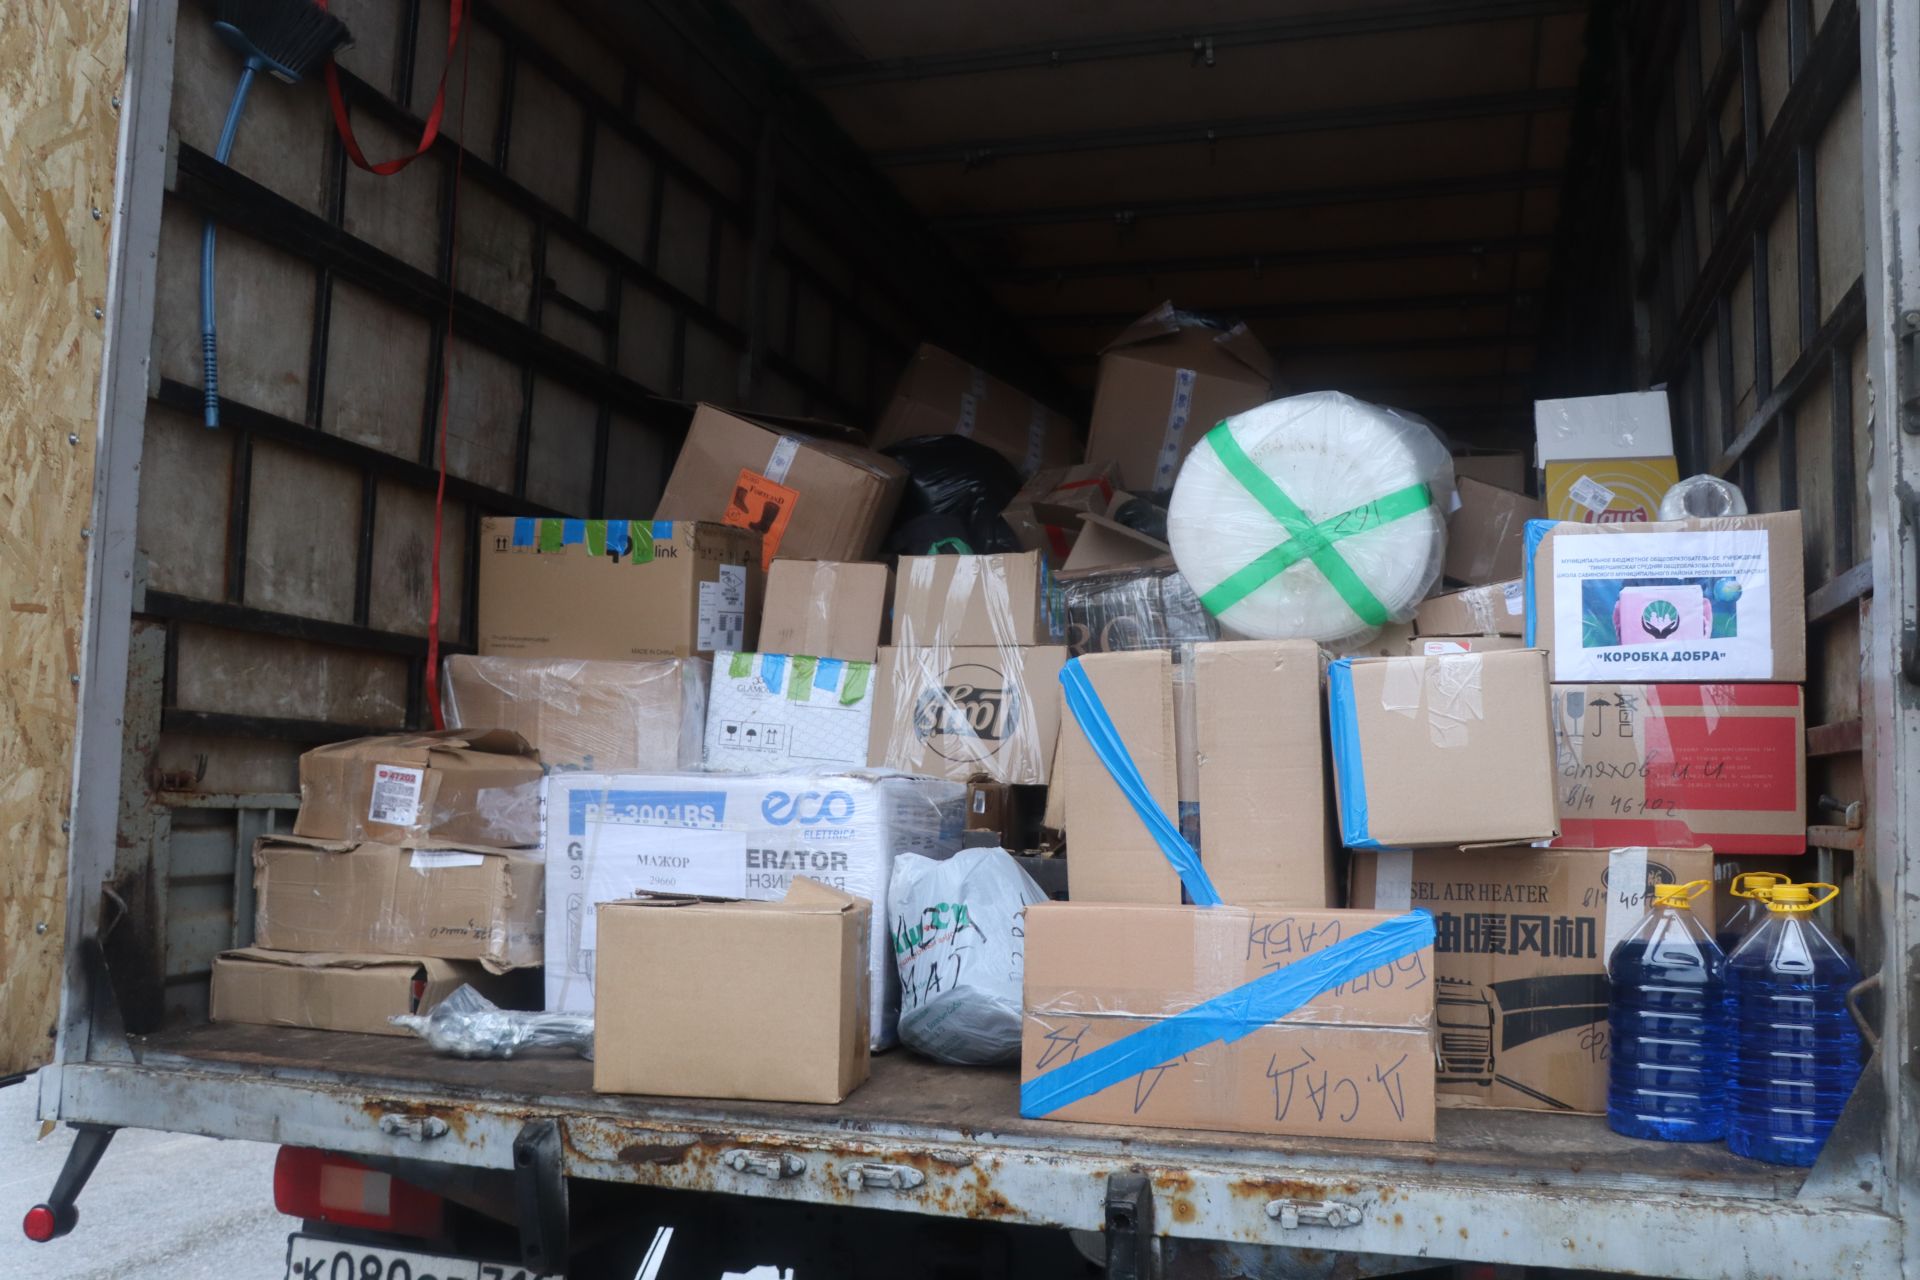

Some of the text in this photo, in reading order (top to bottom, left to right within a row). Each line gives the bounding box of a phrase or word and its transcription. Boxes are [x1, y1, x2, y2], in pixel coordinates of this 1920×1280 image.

[1597, 651, 1726, 663] "КОРОБКА ДОБРА"
[804, 829, 856, 839] ELETTRICA
[637, 854, 690, 869] МАЖОР
[746, 848, 849, 872] ERATOR
[649, 875, 677, 887] 29660
[1444, 884, 1475, 901] AIR
[1476, 884, 1550, 903] HEATER
